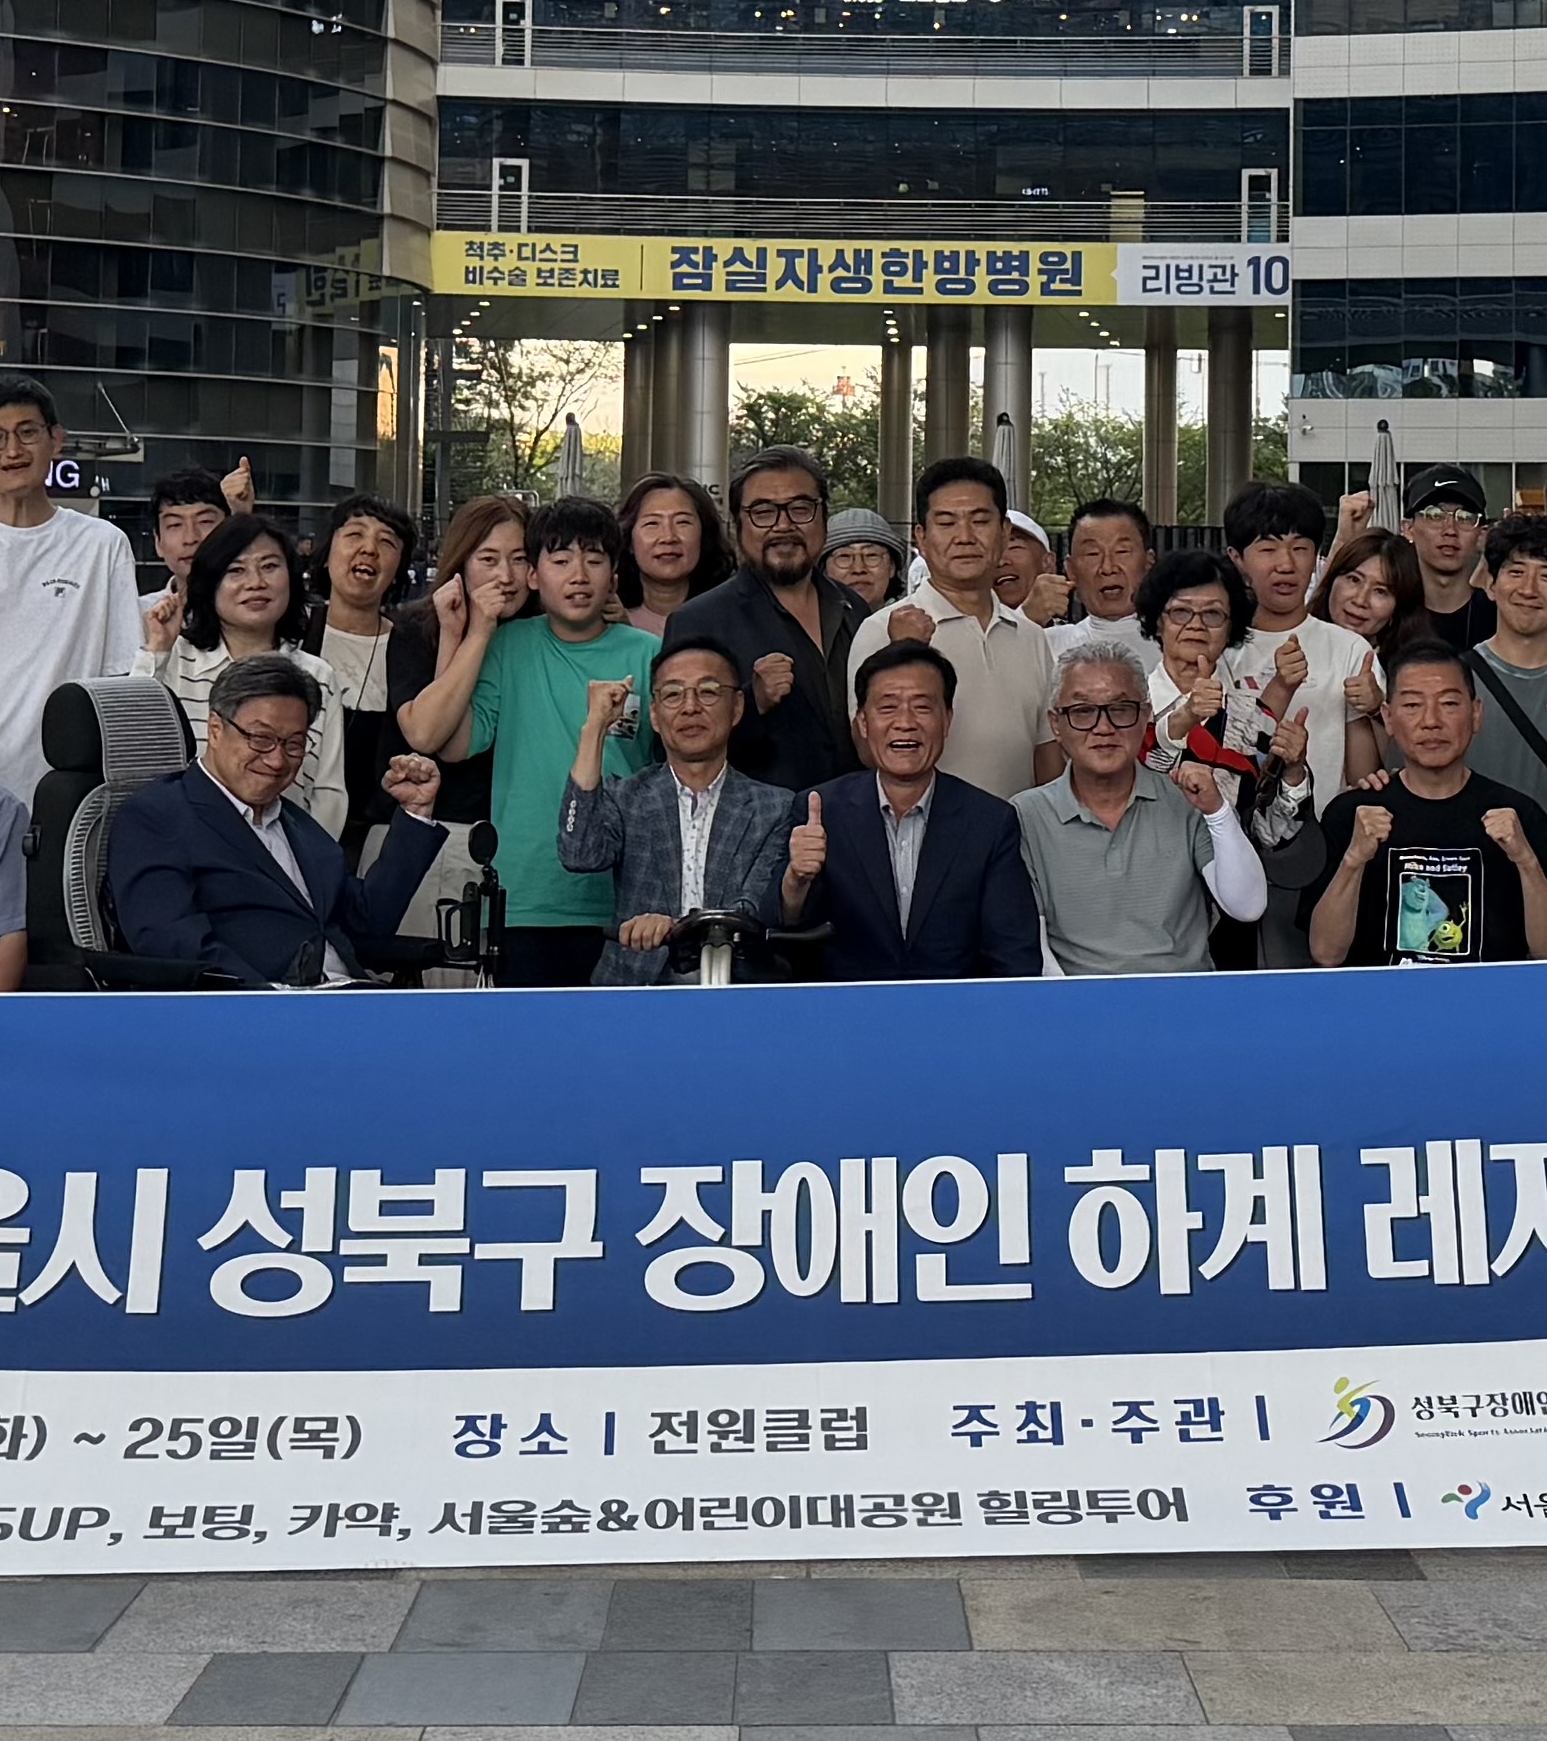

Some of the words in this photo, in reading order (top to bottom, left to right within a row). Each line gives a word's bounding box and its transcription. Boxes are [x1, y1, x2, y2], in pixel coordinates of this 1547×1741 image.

[465, 240, 579, 263] 척추·디스크
[669, 243, 1083, 297] 잠실자생한방병원
[465, 265, 527, 287] 비수술
[535, 267, 619, 288] 보존치료
[1142, 264, 1239, 295] 리빙관
[1247, 256, 1289, 295] 10
[197, 1167, 603, 1316] 성북구
[635, 1153, 1032, 1310] 장애인
[1065, 1145, 1326, 1294] 하계
[123, 1416, 361, 1460] 25일(목)
[453, 1413, 567, 1458] 장소
[649, 1407, 867, 1454] 전원클럽
[143, 1505, 267, 1544] 보팅,
[288, 1503, 411, 1541] 카약,
[429, 1492, 962, 1535] 서울숲&어린이대공원
[977, 1488, 1188, 1525] 힐링투어
[1247, 1484, 1365, 1520] 후원
